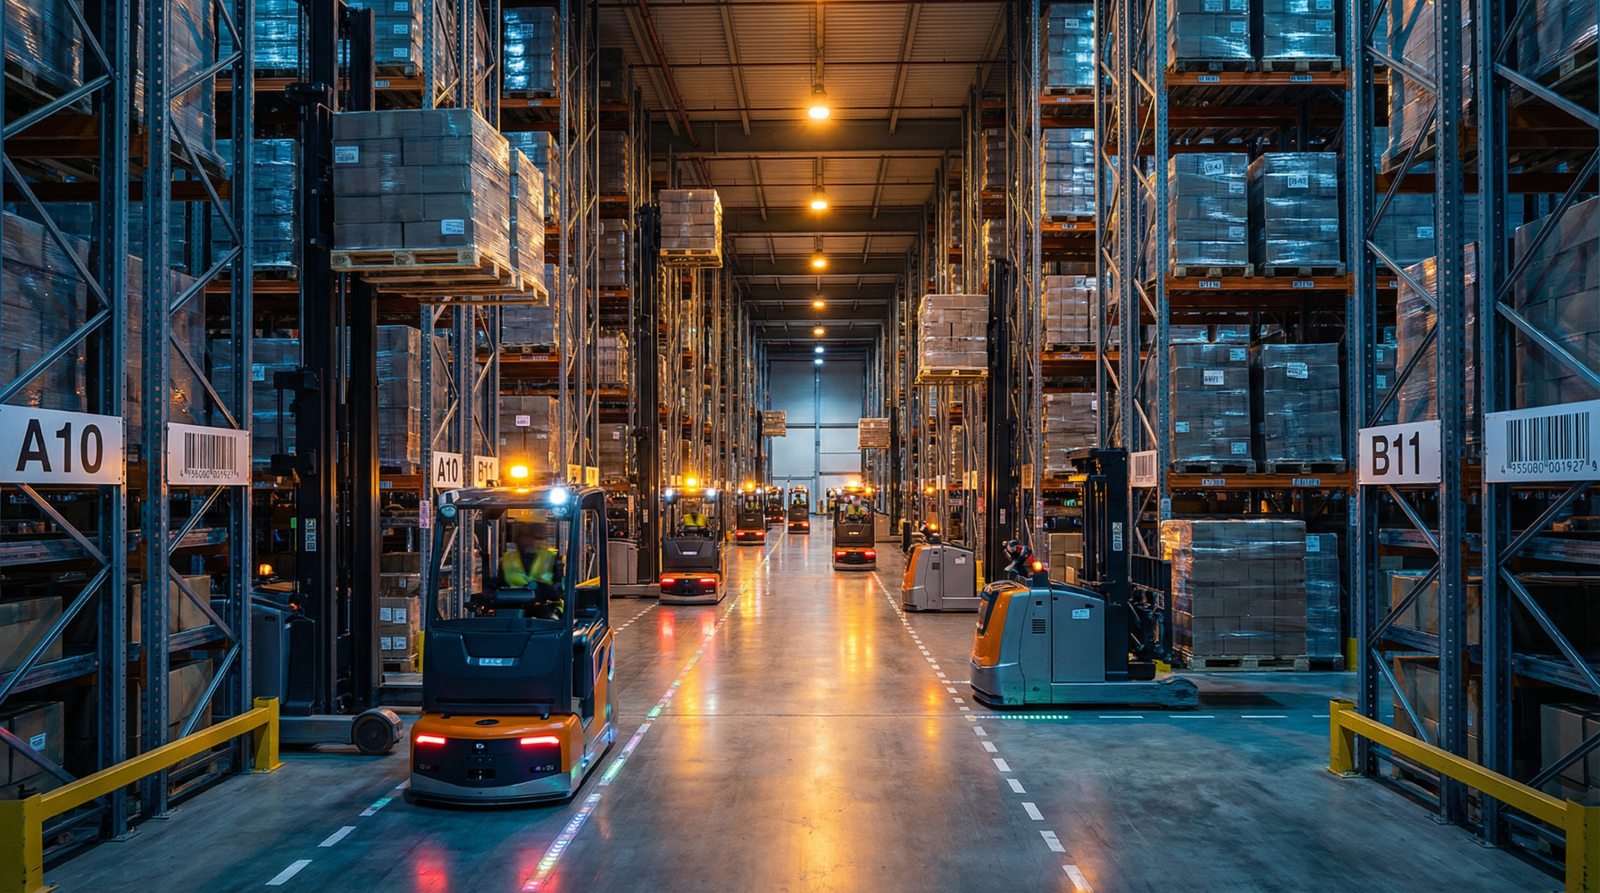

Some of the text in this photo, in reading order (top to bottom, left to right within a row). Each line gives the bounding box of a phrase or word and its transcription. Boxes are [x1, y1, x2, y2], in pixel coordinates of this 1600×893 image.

[15, 418, 103, 474] A10
[1372, 431, 1420, 476] B11
[437, 457, 458, 482] A10
[478, 461, 493, 482] B11
[1548, 460, 1585, 473] 001927
